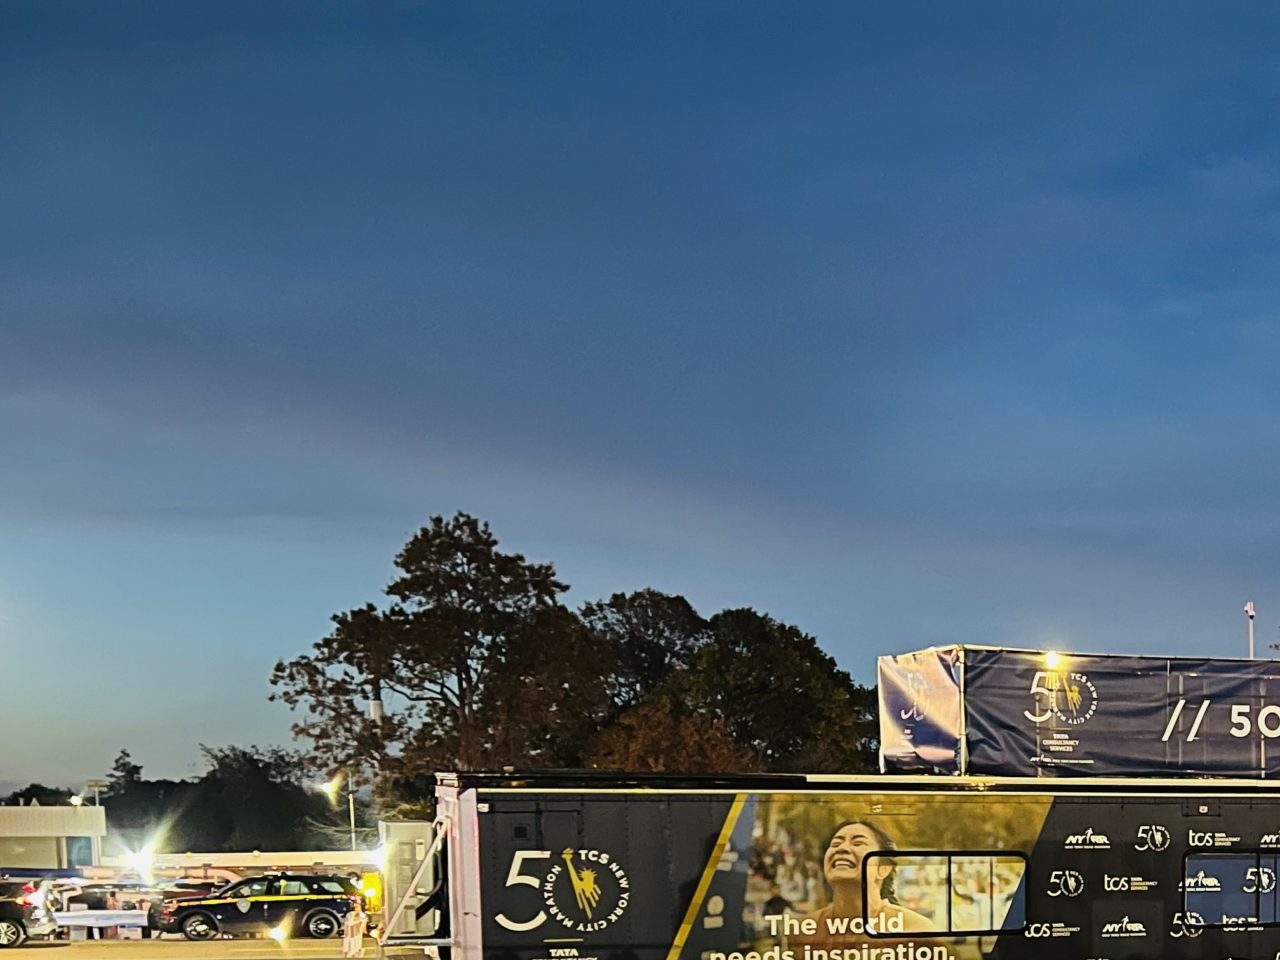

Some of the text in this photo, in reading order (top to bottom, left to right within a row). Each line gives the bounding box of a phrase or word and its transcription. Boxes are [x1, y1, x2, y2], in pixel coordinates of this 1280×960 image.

[1189, 829, 1213, 847] tcs
[543, 849, 630, 932] TCS NEW YORK CITY MARATHON
[1104, 874, 1129, 891] tcs
[764, 912, 905, 936] The world
[549, 948, 579, 957] TATA
